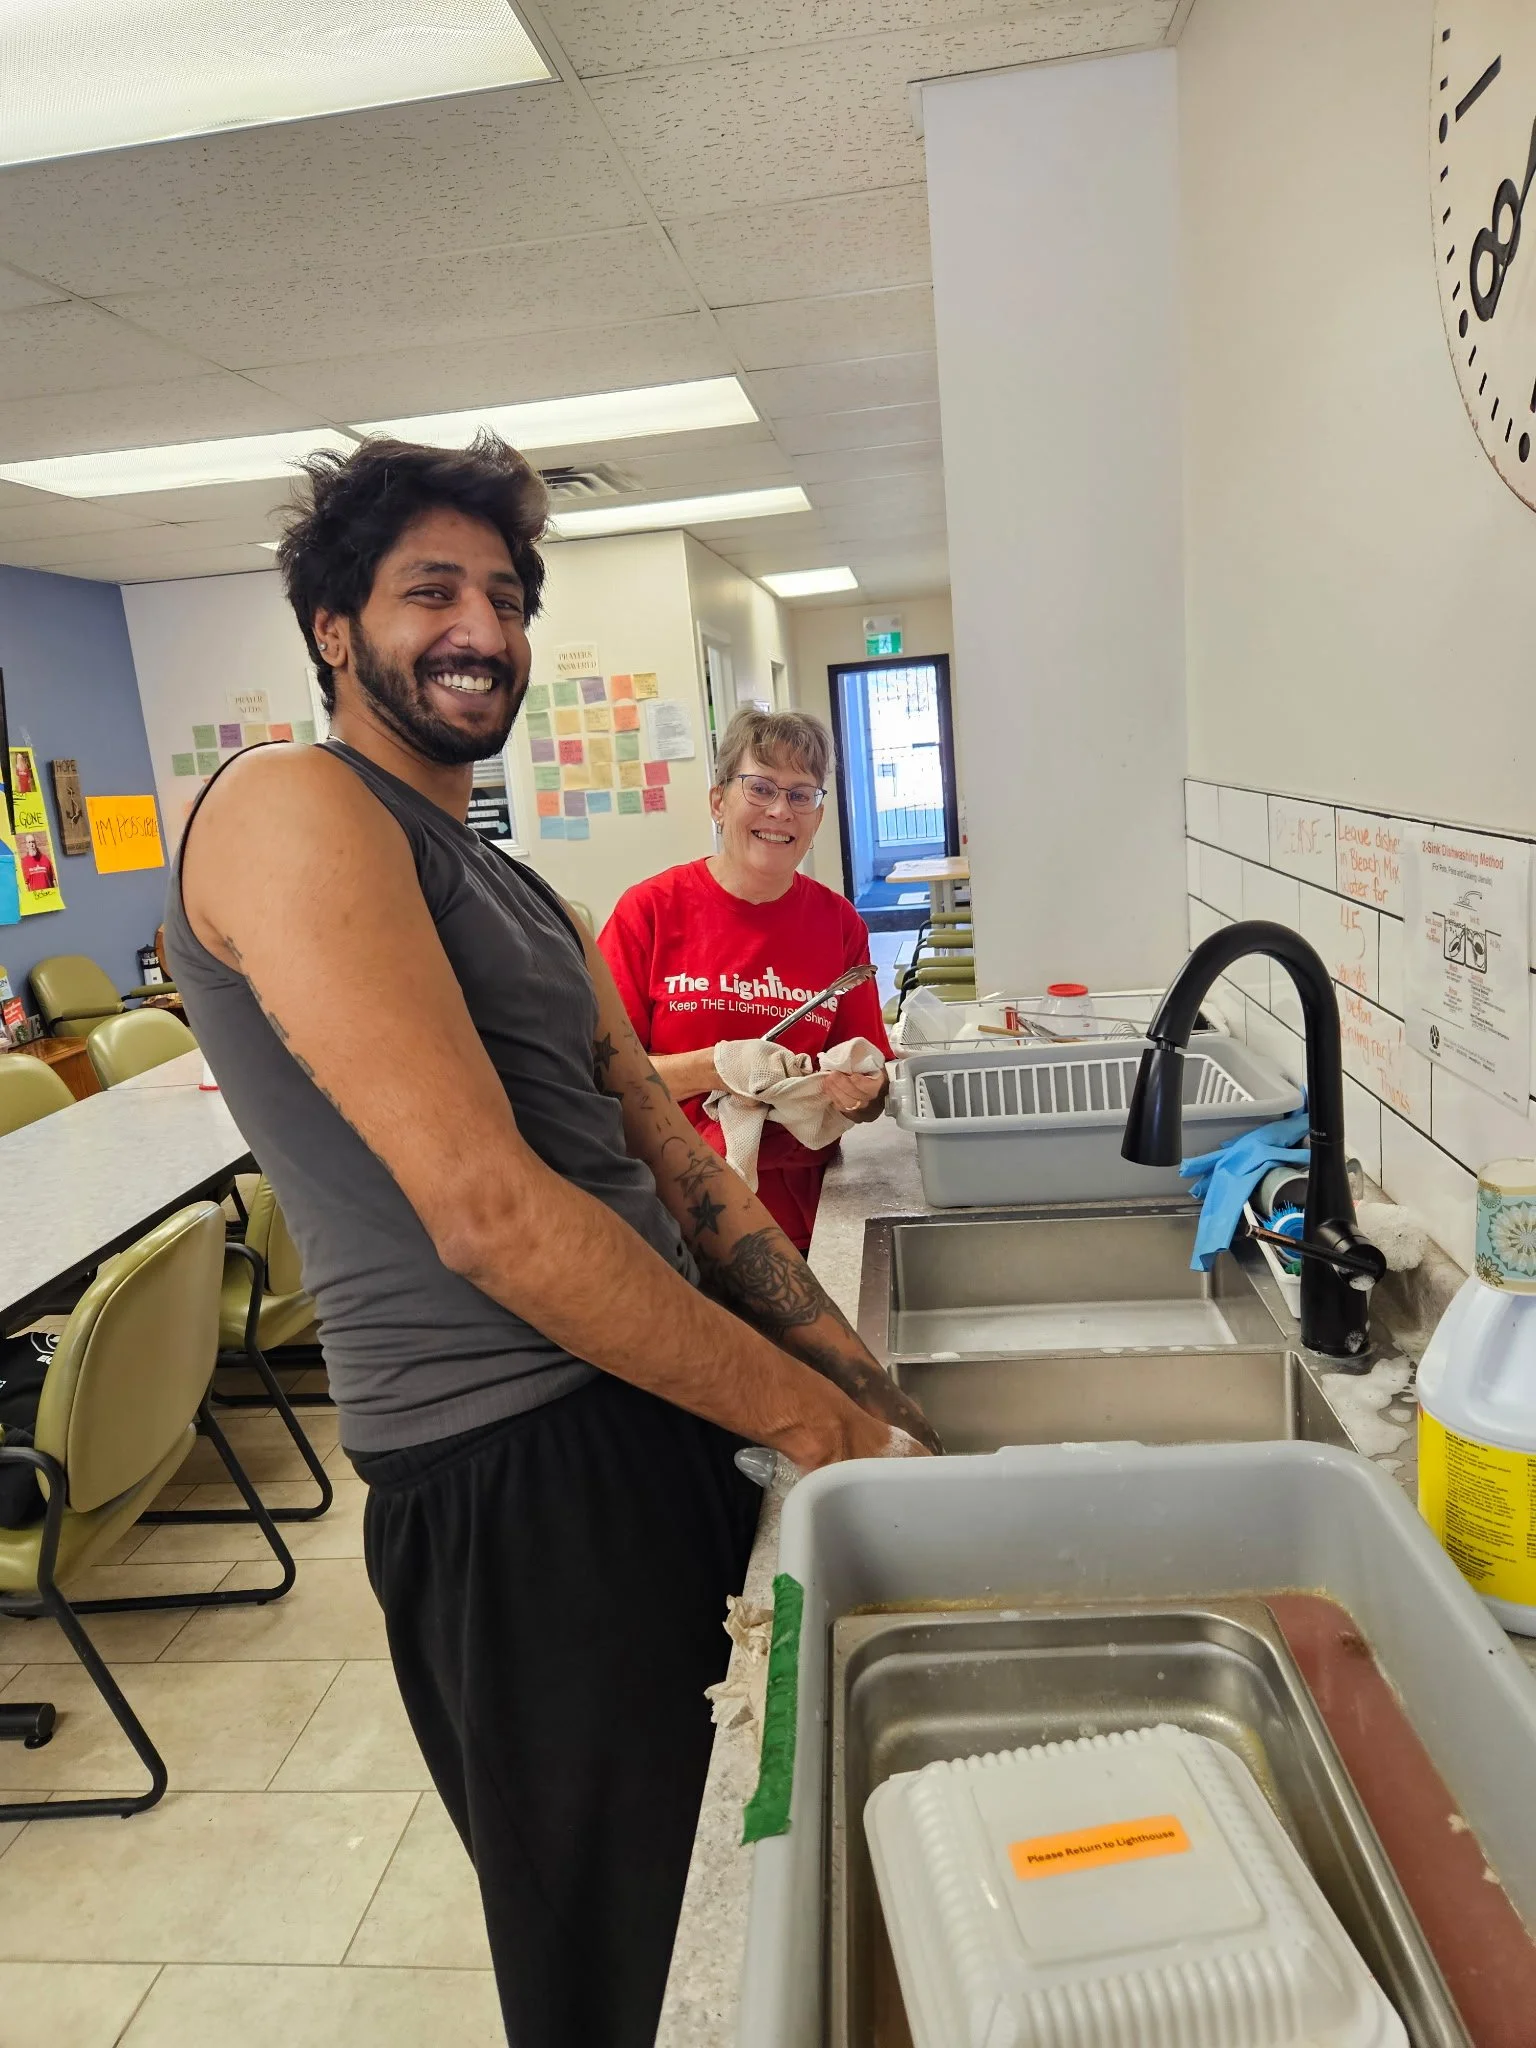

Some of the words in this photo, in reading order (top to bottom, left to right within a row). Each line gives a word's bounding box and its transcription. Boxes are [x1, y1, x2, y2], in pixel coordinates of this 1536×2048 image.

[1470, 178, 1521, 322] 8
[557, 661, 597, 671] ANSWERED
[559, 651, 592, 661] PRAYERS
[56, 760, 76, 773] HOPE
[19, 811, 44, 828] GONE
[1336, 815, 1371, 846] Leave
[1422, 841, 1440, 856] 2-Sink
[1441, 845, 1479, 867] Dishwashing
[1480, 852, 1504, 870] Method
[664, 972, 709, 994] The
[720, 966, 838, 1013] Lighthoue
[669, 1001, 698, 1013] Keep
[701, 998, 726, 1010] THE
[729, 1000, 801, 1018] LIGHTHOUS
[1026, 1851, 1064, 1864] Please
[1065, 1843, 1102, 1856] Return
[1103, 1840, 1115, 1850] to
[1115, 1830, 1176, 1847] Lighthouse
